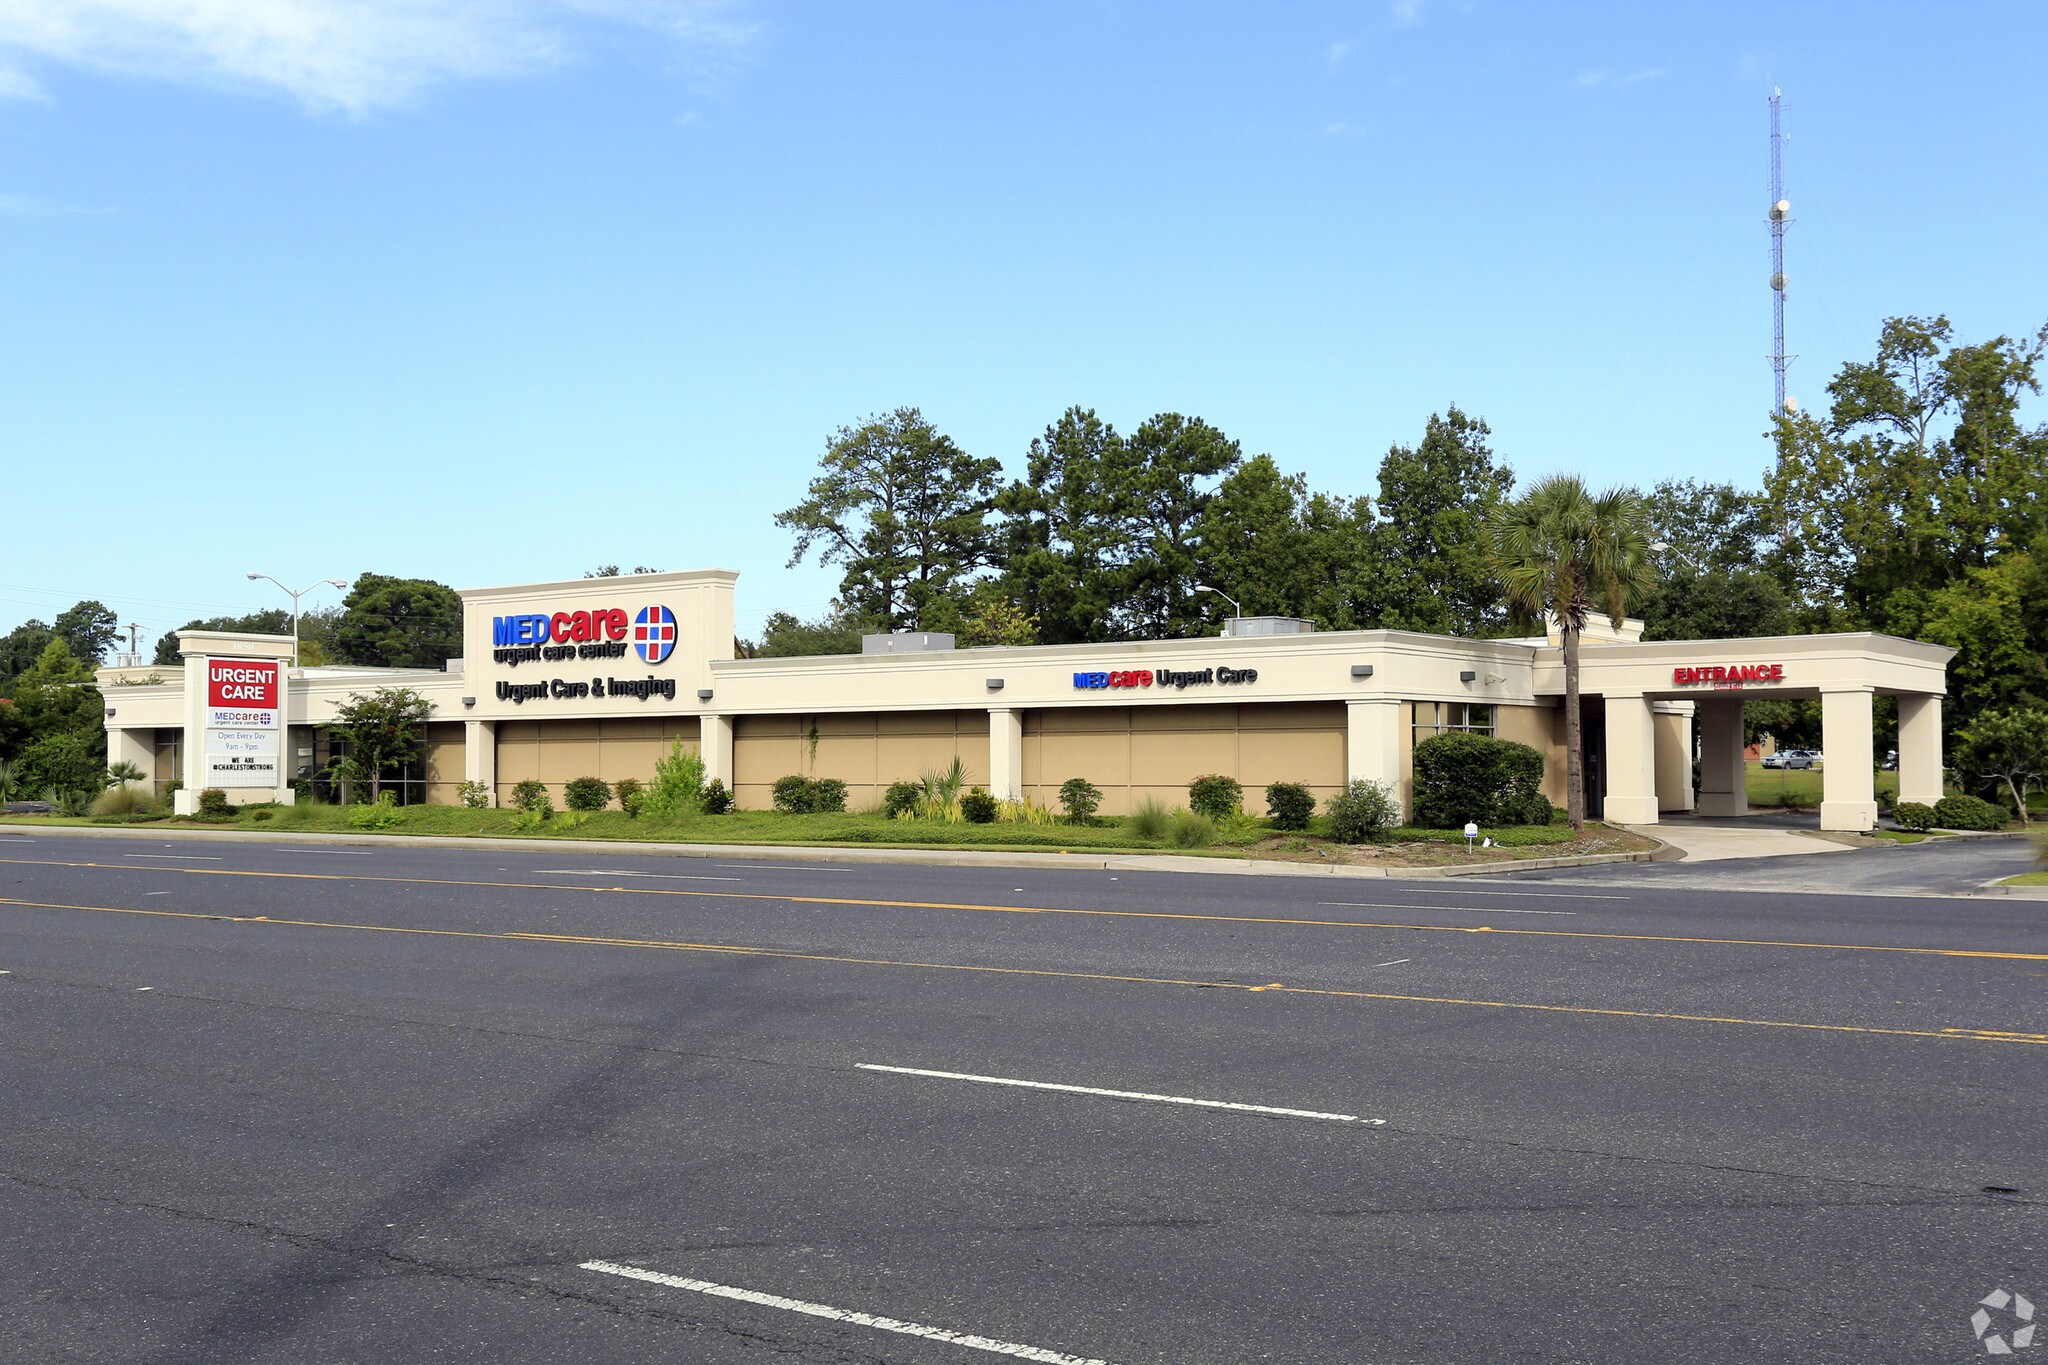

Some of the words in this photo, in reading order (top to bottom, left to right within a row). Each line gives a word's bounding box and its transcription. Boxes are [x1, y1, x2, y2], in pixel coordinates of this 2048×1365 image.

[493, 608, 628, 646] MEDcare
[493, 645, 541, 666] urgent
[543, 645, 576, 661] care
[578, 641, 628, 659] center
[211, 667, 275, 684] URGENT
[1073, 669, 1153, 688] MEDcare
[1156, 668, 1213, 688] Urgent
[1216, 666, 1258, 683] Care
[1674, 664, 1784, 683] ENTRANCE
[221, 684, 265, 700] CARE
[496, 679, 548, 702] Urgent
[551, 678, 589, 698] Care
[591, 677, 605, 697] &
[607, 675, 675, 701] Imaging
[215, 712, 259, 721] MEDcare
[218, 732, 235, 740] Open
[237, 732, 253, 740] Every
[245, 743, 258, 751] 9pm
